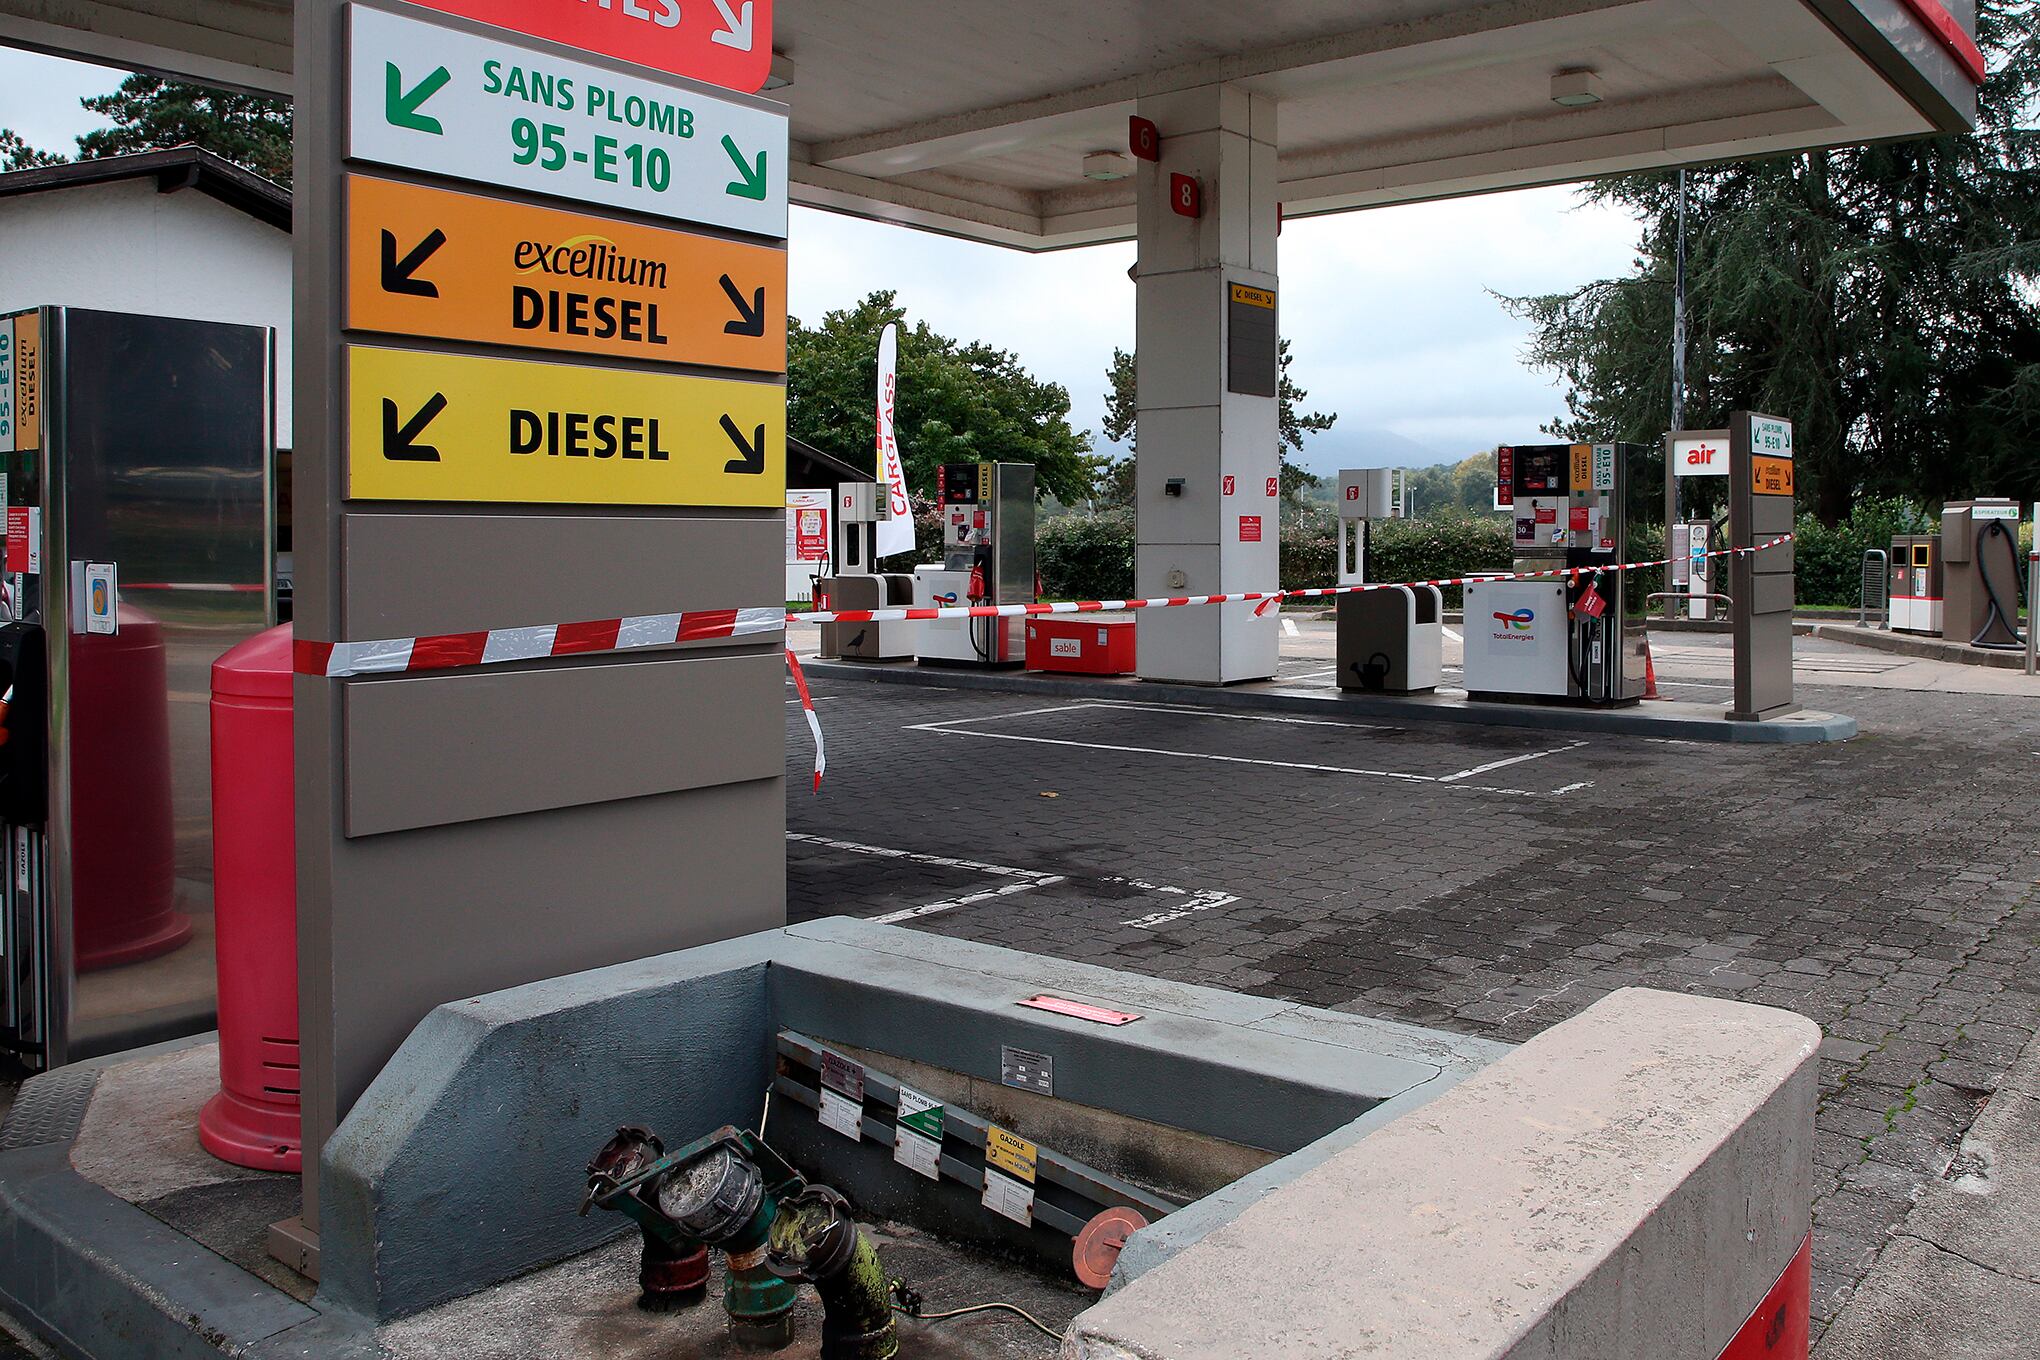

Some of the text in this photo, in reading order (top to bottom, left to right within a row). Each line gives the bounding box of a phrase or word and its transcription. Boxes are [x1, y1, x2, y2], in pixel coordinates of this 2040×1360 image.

[483, 59, 695, 139] SANS PLOMB
[1140, 127, 1150, 150] 6
[511, 117, 671, 193] 95-E10
[1181, 183, 1191, 207] 8
[514, 240, 667, 289] excellium
[1244, 288, 1262, 302] DIESEL
[512, 285, 668, 345] DIESEL
[0, 333, 9, 437] 95-E10
[509, 408, 670, 461] DIESEL
[885, 373, 907, 516] CARGLASS
[1764, 435, 1780, 449] 95-E10
[1687, 444, 1716, 465] air
[1602, 449, 1611, 485] 95-E10
[1765, 478, 1781, 490] DIESEL
[1054, 642, 1077, 654] sable
[1493, 633, 1534, 641] TotalEnergies
[999, 1133, 1025, 1151] GAZOLE
